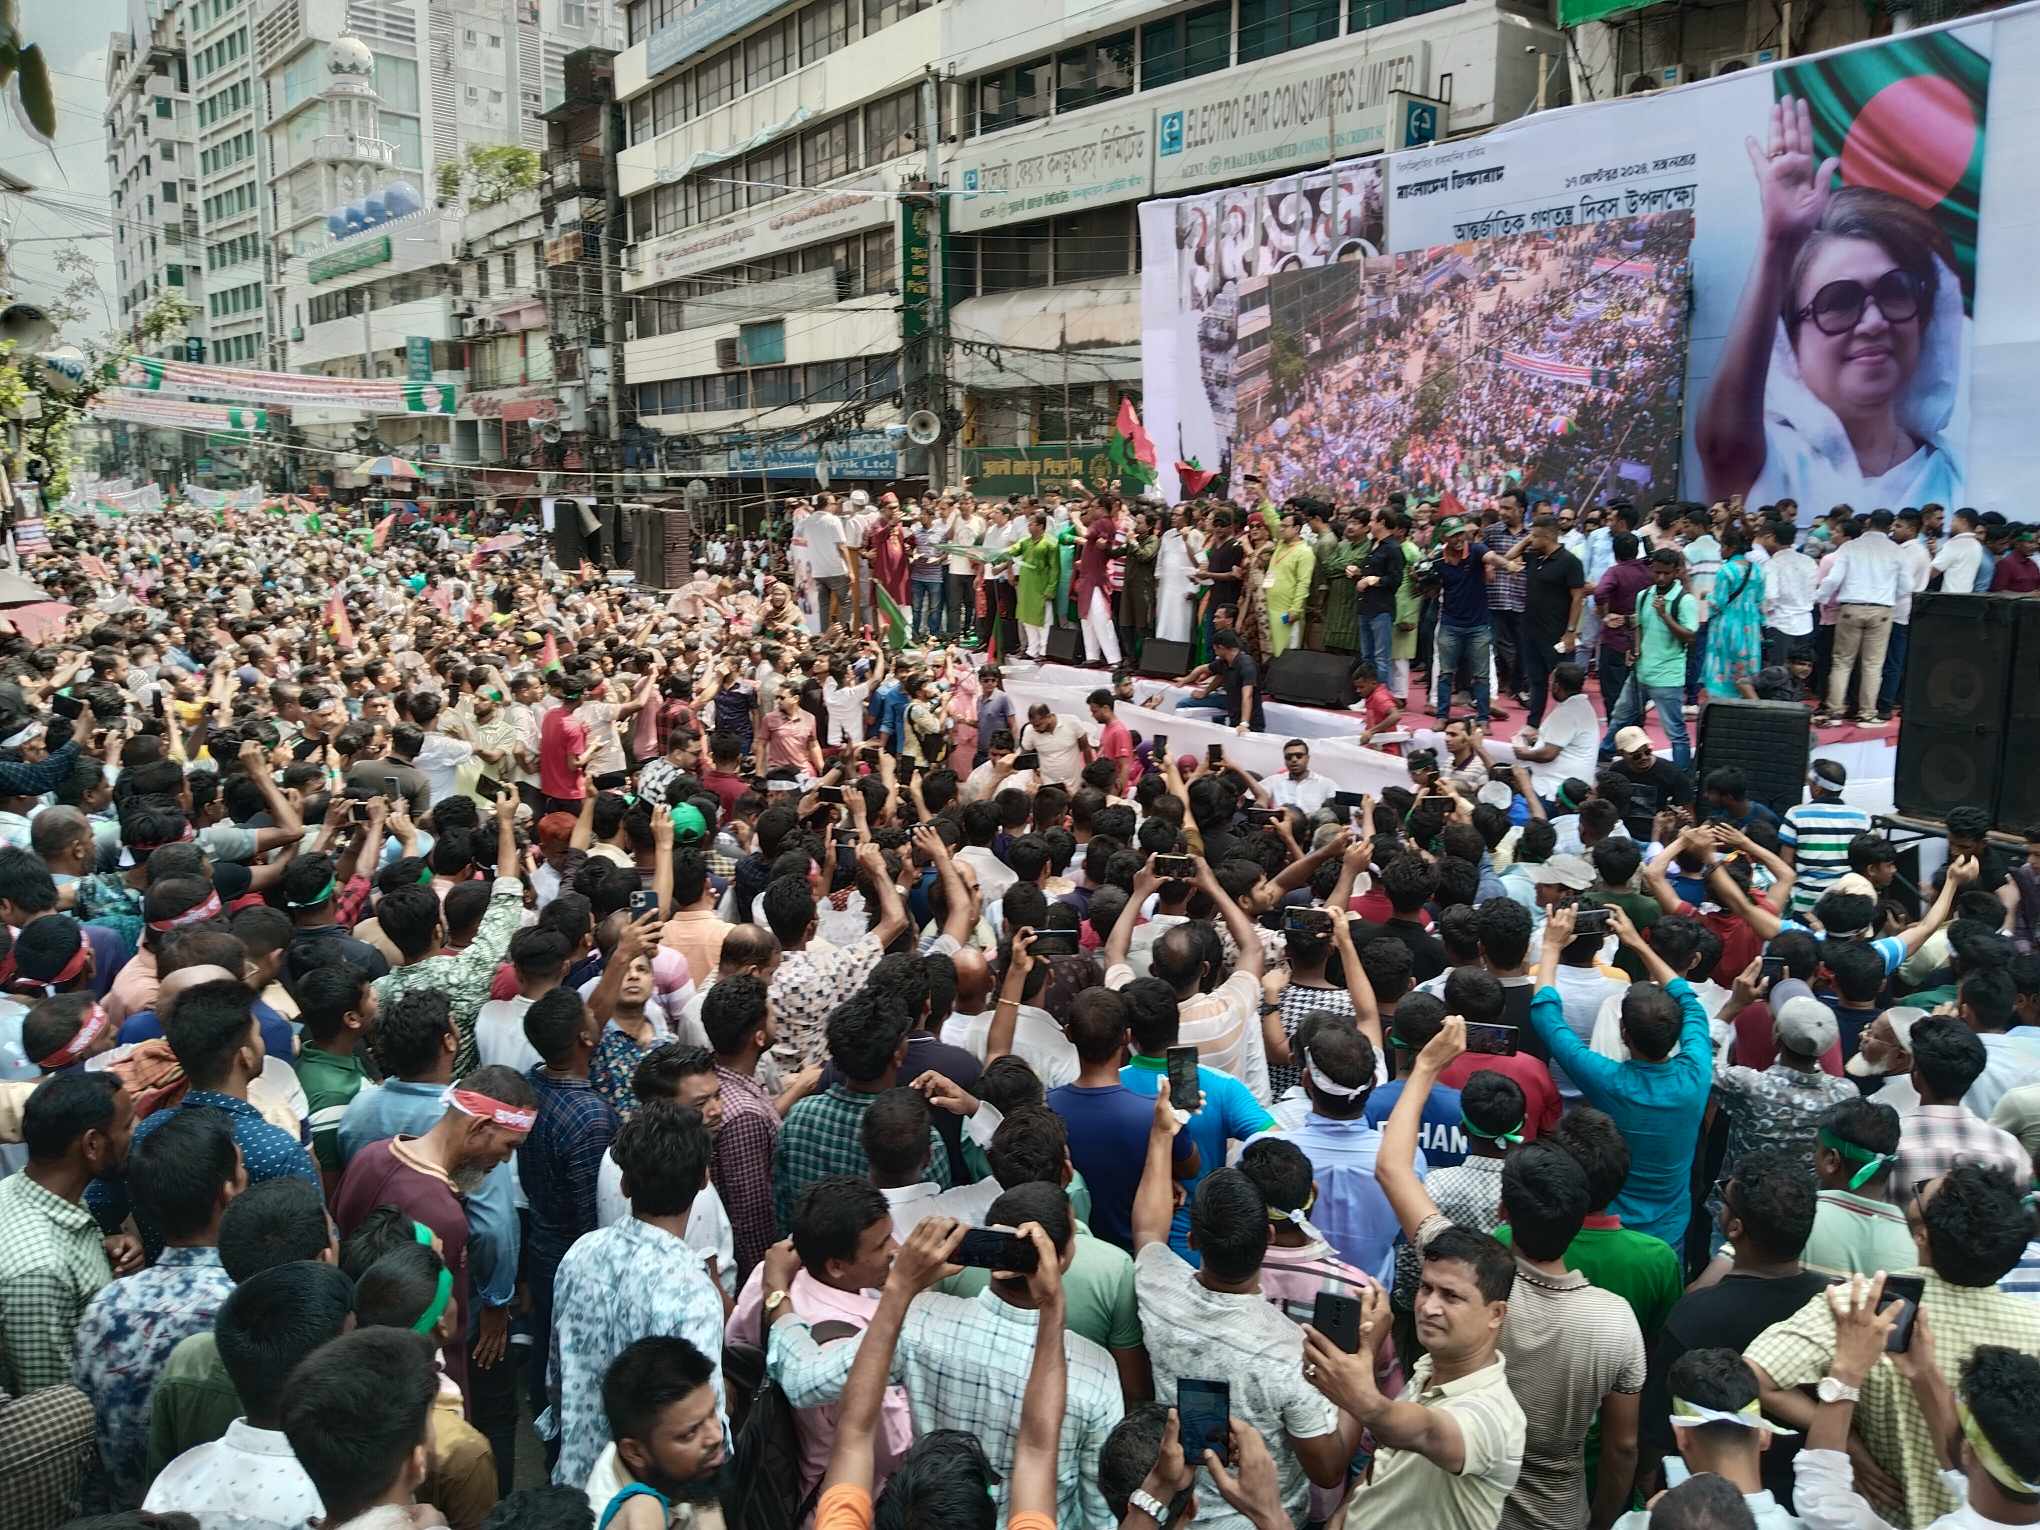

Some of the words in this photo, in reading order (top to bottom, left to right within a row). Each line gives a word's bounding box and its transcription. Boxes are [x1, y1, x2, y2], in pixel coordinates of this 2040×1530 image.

[1186, 98, 1240, 149] ELECTRO
[1242, 90, 1270, 134] FAIR
[1272, 67, 1355, 130] CONSUMERS
[1357, 54, 1415, 111] LIMITED
[1579, 194, 1620, 223] দিবস
[863, 460, 895, 469] Ltd.
